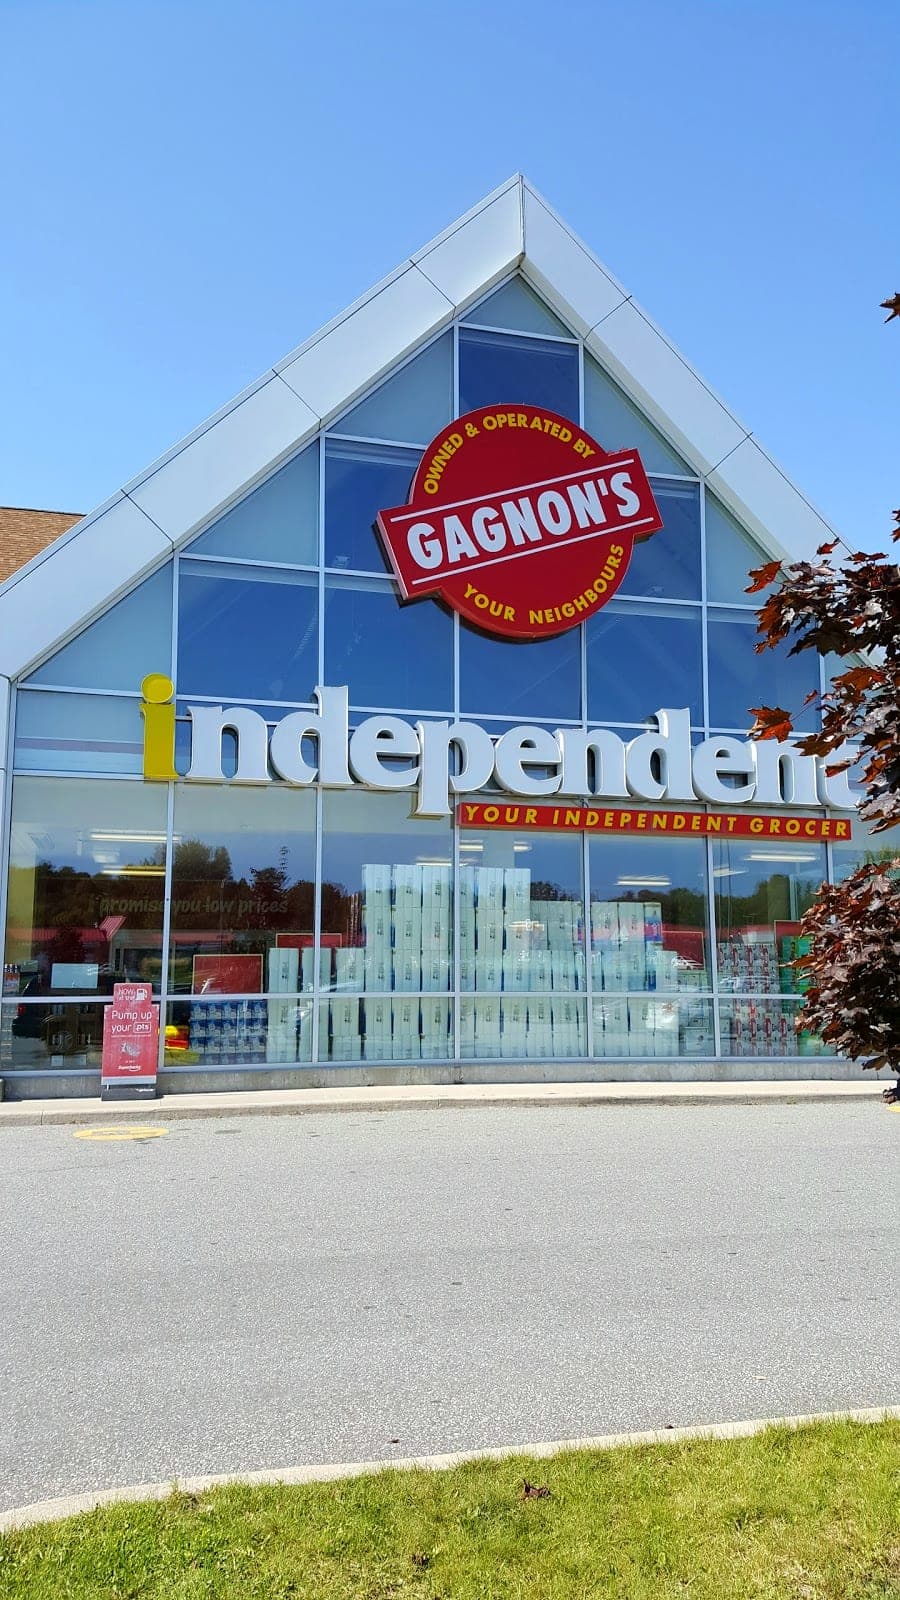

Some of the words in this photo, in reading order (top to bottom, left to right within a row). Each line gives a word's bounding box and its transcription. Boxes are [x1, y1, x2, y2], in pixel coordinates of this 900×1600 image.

[423, 433, 464, 494] OWNED
[465, 423, 479, 437] &
[482, 413, 572, 442] OPERATED
[573, 438, 594, 459] BY
[406, 472, 640, 569] GAGNON'S
[463, 583, 515, 621] YOUR
[529, 544, 624, 624] NEIGHBOURS
[465, 805, 538, 824] YOUR
[552, 809, 737, 832] INDEPENDENT
[749, 817, 847, 836] GROCER
[238, 897, 289, 917] prices
[111, 1010, 138, 1021] Pump
[140, 1011, 152, 1021] up
[111, 1024, 132, 1035] your
